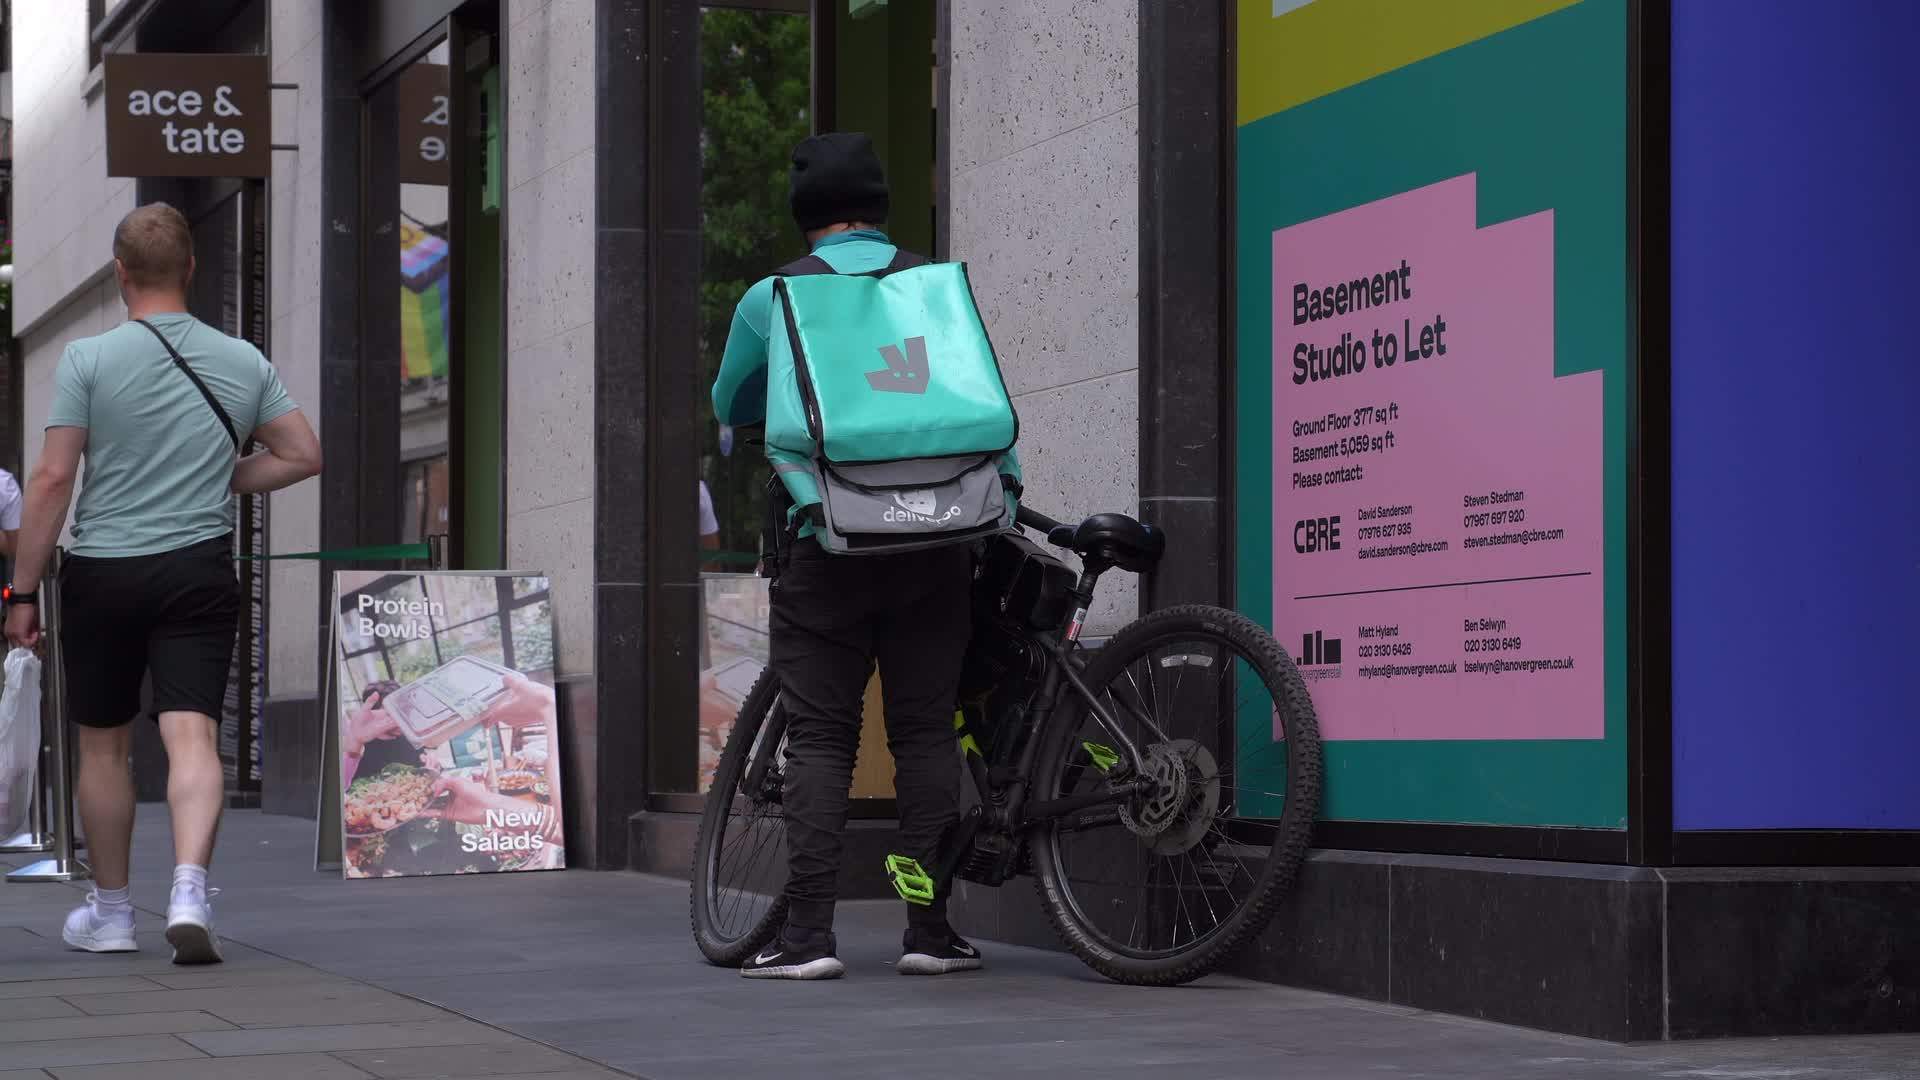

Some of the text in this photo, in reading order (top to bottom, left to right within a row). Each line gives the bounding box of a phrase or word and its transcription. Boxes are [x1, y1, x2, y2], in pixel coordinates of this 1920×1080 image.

[128, 85, 243, 116] ace &
[162, 122, 244, 154] tate
[1293, 259, 1411, 326] Basement
[1292, 314, 1446, 385] Studio to Let
[1292, 402, 1398, 437] Ground Floor 377 sq ft
[1292, 430, 1394, 464] Basement 5,059 sq ft
[1292, 464, 1363, 490] Please contact:
[1464, 490, 1524, 508] Steven Stedman
[1358, 504, 1412, 520] David Sanderson
[1464, 509, 1525, 528] 07967 697 920
[1294, 516, 1341, 553] CBRE
[1358, 522, 1412, 540] 07976 627 935
[1464, 527, 1564, 548] steven.stedman@cbre.com
[1358, 540, 1448, 559] david.sanderson@cbre.com
[358, 594, 444, 616] Protein
[358, 618, 432, 639] Bowls
[1358, 624, 1398, 640] Matt Hyland
[1464, 617, 1506, 633] Ben Selwyn
[1358, 643, 1412, 658] 020 3130 6426
[1464, 637, 1521, 652] 020 3130 6419
[1358, 661, 1457, 680] mhyland@hanovergreen.co.uk
[1464, 656, 1574, 676] bselwyn@hanovergreen.co.uk
[485, 808, 543, 828] New
[461, 832, 544, 852] Salads
